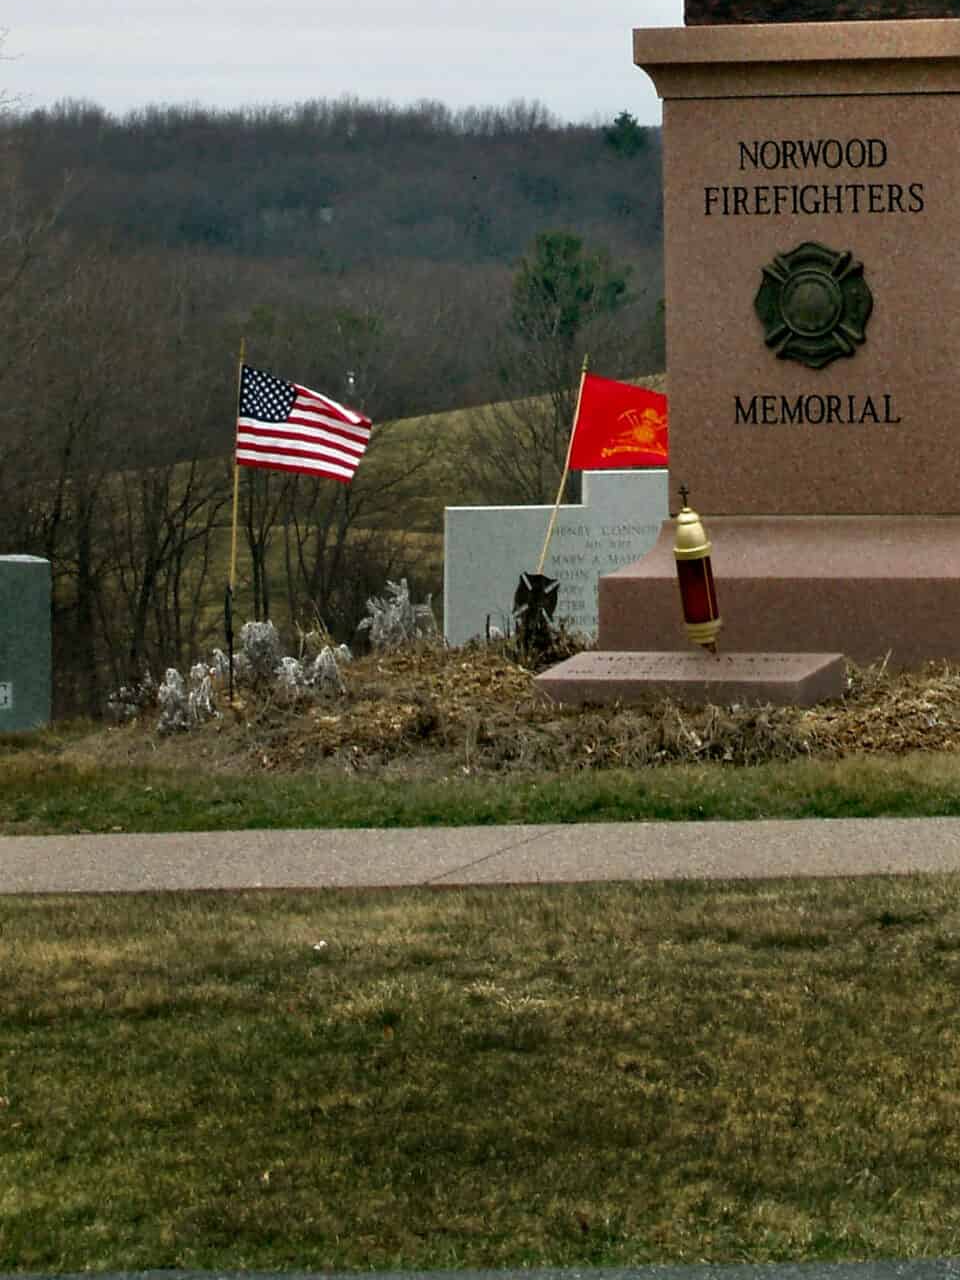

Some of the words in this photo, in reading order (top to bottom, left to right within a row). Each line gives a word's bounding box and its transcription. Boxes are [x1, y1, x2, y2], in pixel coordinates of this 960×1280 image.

[738, 138, 888, 170] NORWOOD
[703, 182, 925, 216] FIREFIGHTERS
[733, 394, 902, 425] MEMORIAL
